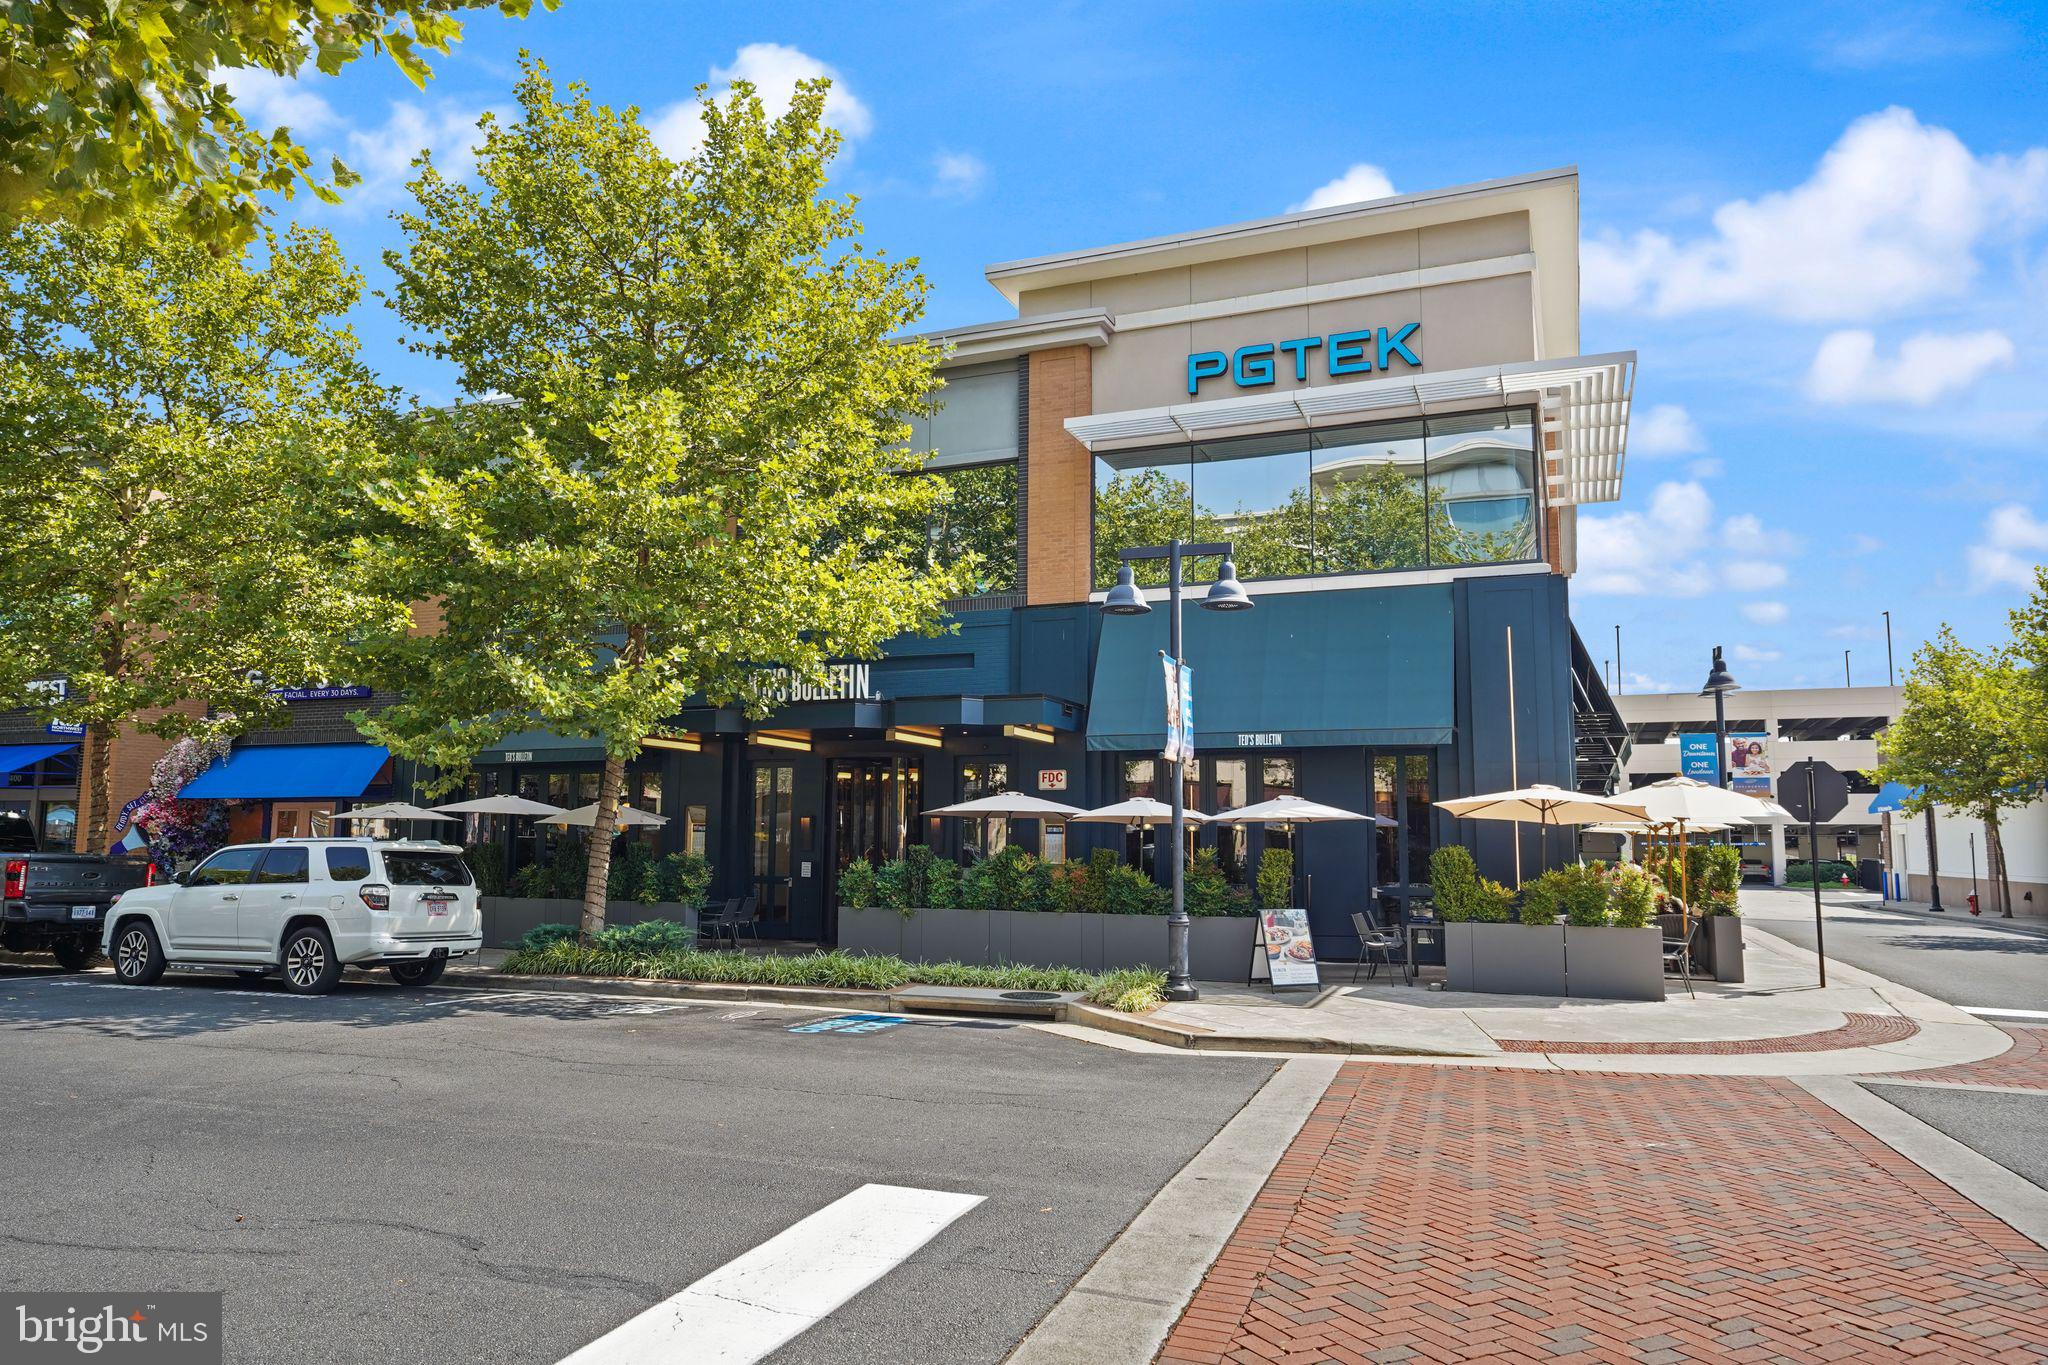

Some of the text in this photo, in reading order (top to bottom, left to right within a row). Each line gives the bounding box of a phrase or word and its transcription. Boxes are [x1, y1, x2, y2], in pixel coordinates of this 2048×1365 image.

[1187, 322, 1422, 396] PGTEK
[309, 690, 330, 698] EVERY
[330, 688, 340, 697] 30
[340, 687, 359, 696] DAYS.
[1237, 733, 1282, 746] TED'S BULLETIN
[1041, 772, 1063, 783] FDC
